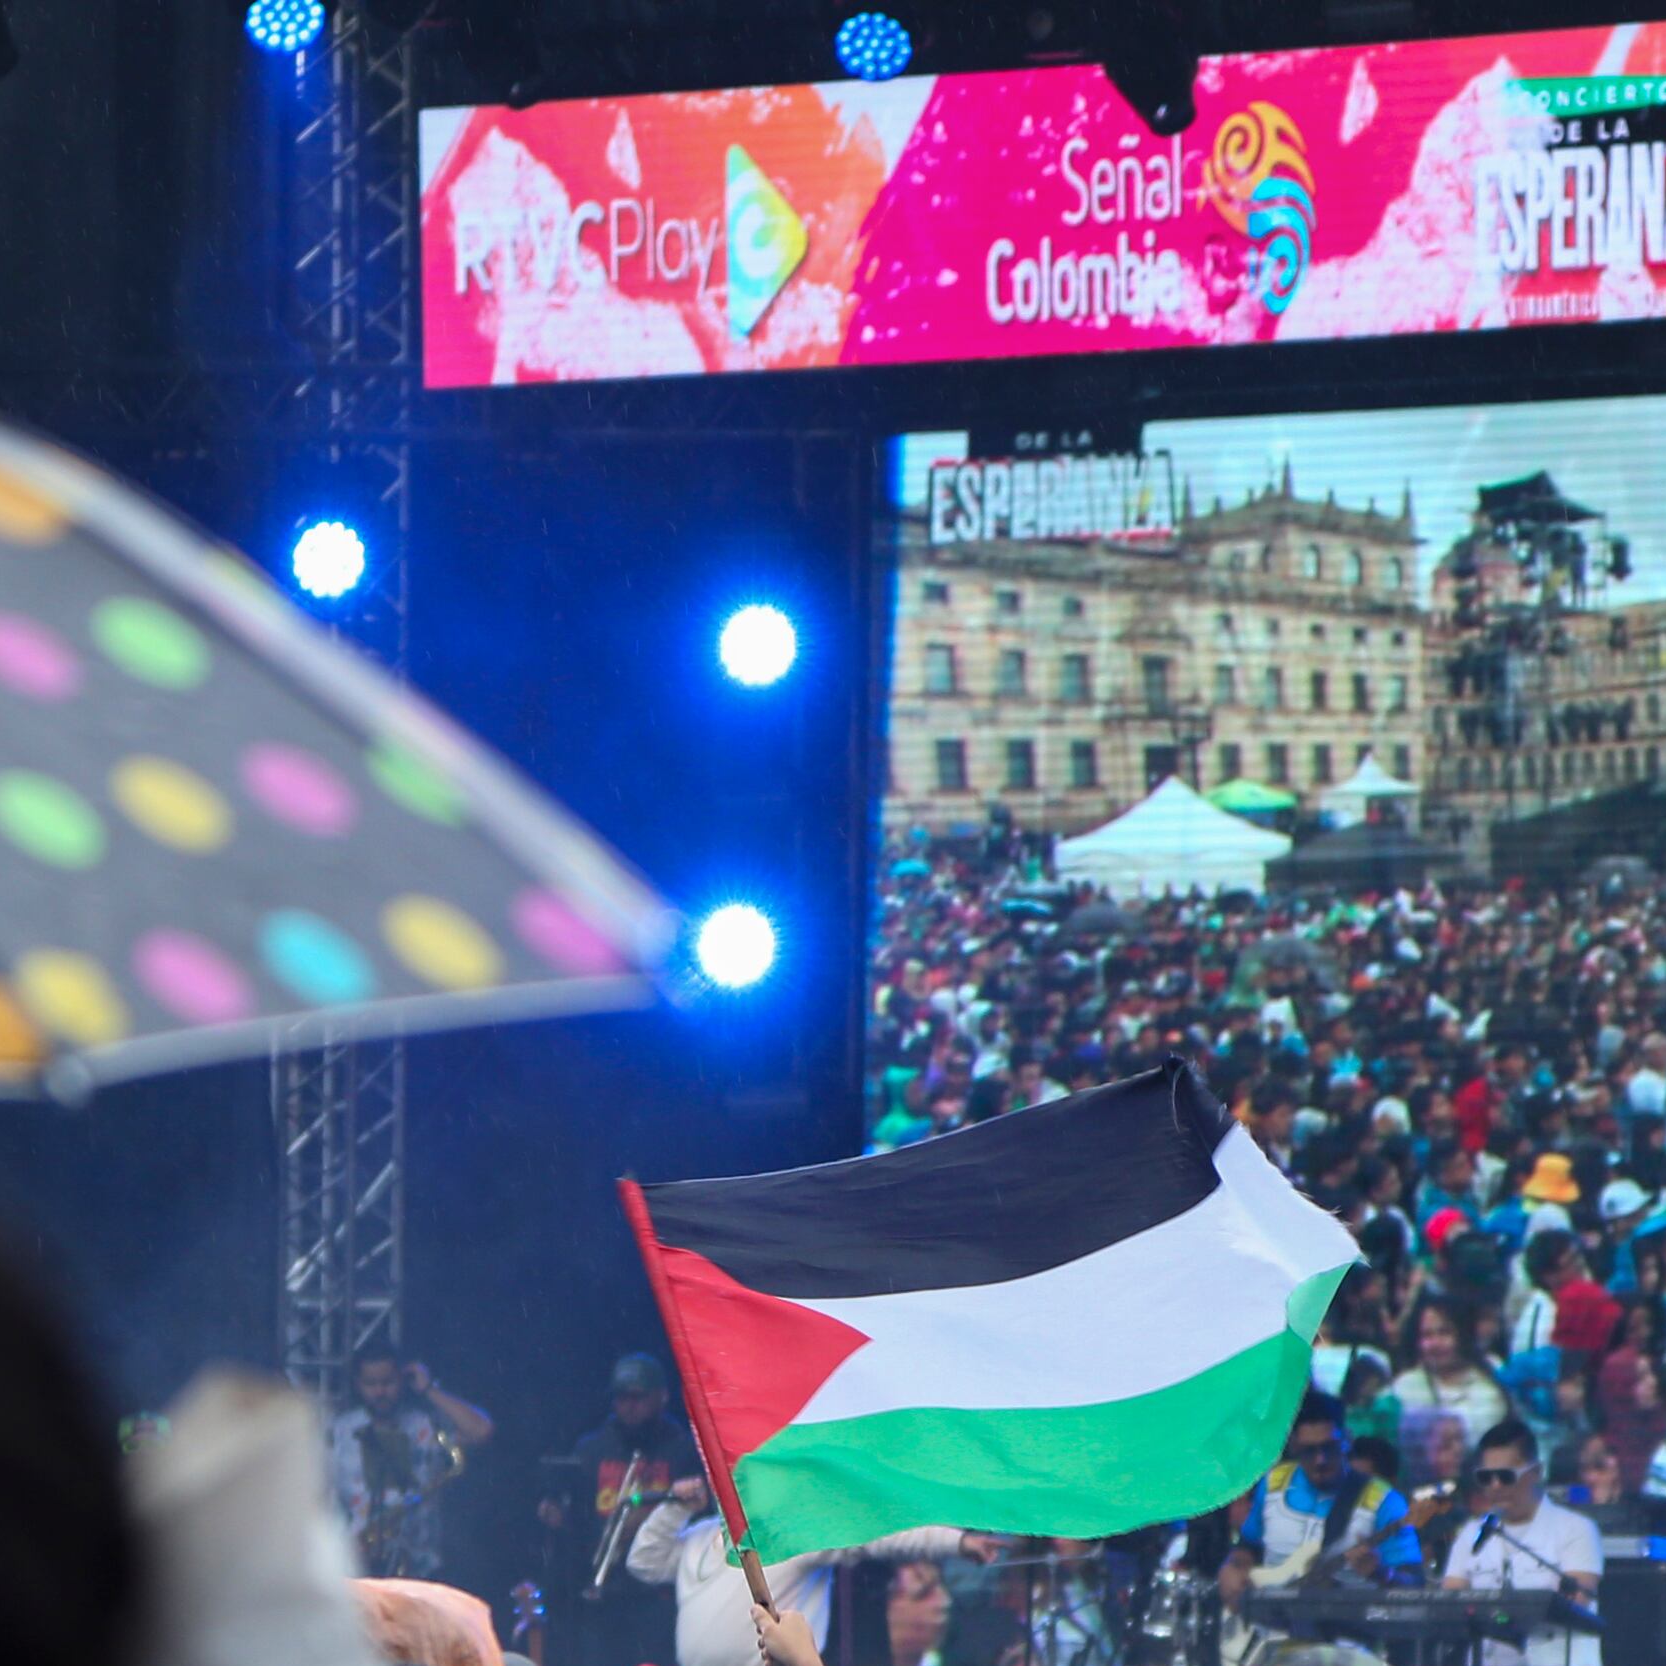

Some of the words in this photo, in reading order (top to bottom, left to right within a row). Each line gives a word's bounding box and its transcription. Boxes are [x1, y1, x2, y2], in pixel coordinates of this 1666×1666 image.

[1550, 121, 1582, 143] DE
[1598, 118, 1630, 140] LA
[1061, 132, 1182, 226] Señal
[986, 229, 1183, 324] Colombia
